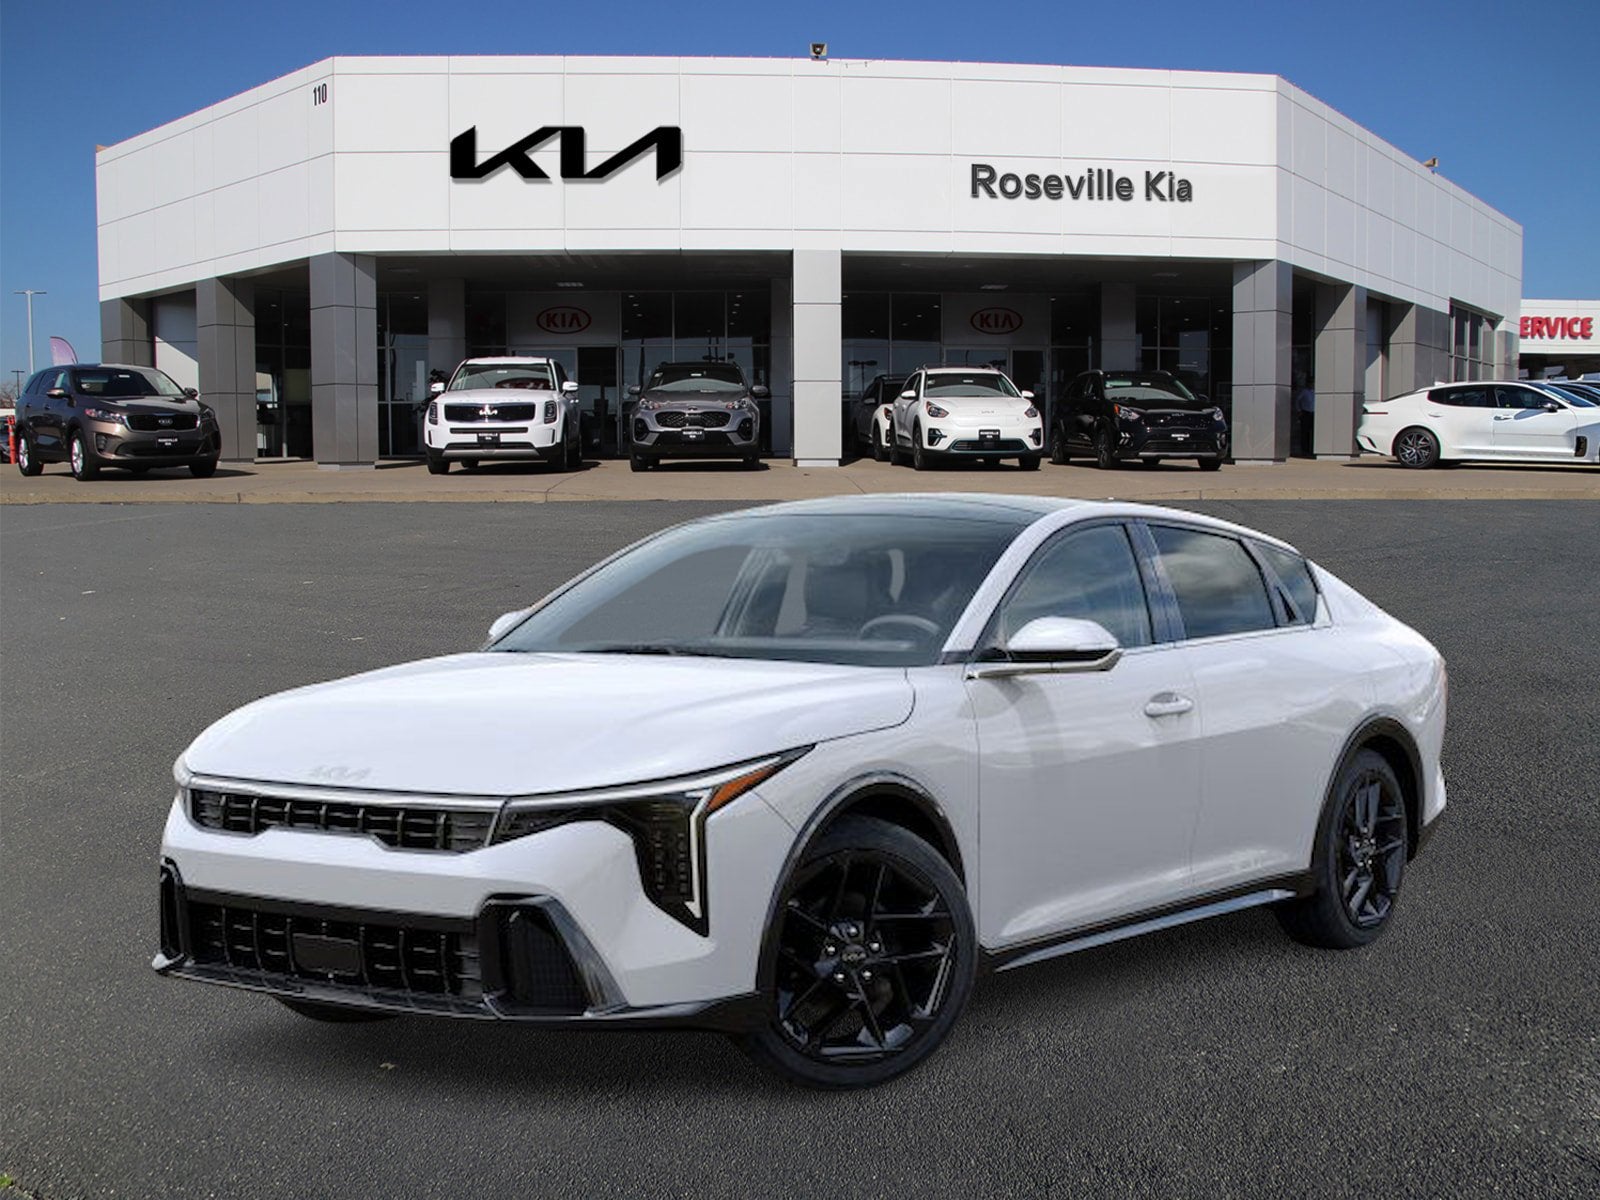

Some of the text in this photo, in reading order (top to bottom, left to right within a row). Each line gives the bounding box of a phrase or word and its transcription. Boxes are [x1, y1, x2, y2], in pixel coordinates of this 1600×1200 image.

[313, 83, 327, 106] 110
[451, 126, 682, 182] KIA
[971, 164, 1193, 202] Roseville Kia
[546, 312, 582, 328] KIA
[980, 313, 1014, 328] KIA
